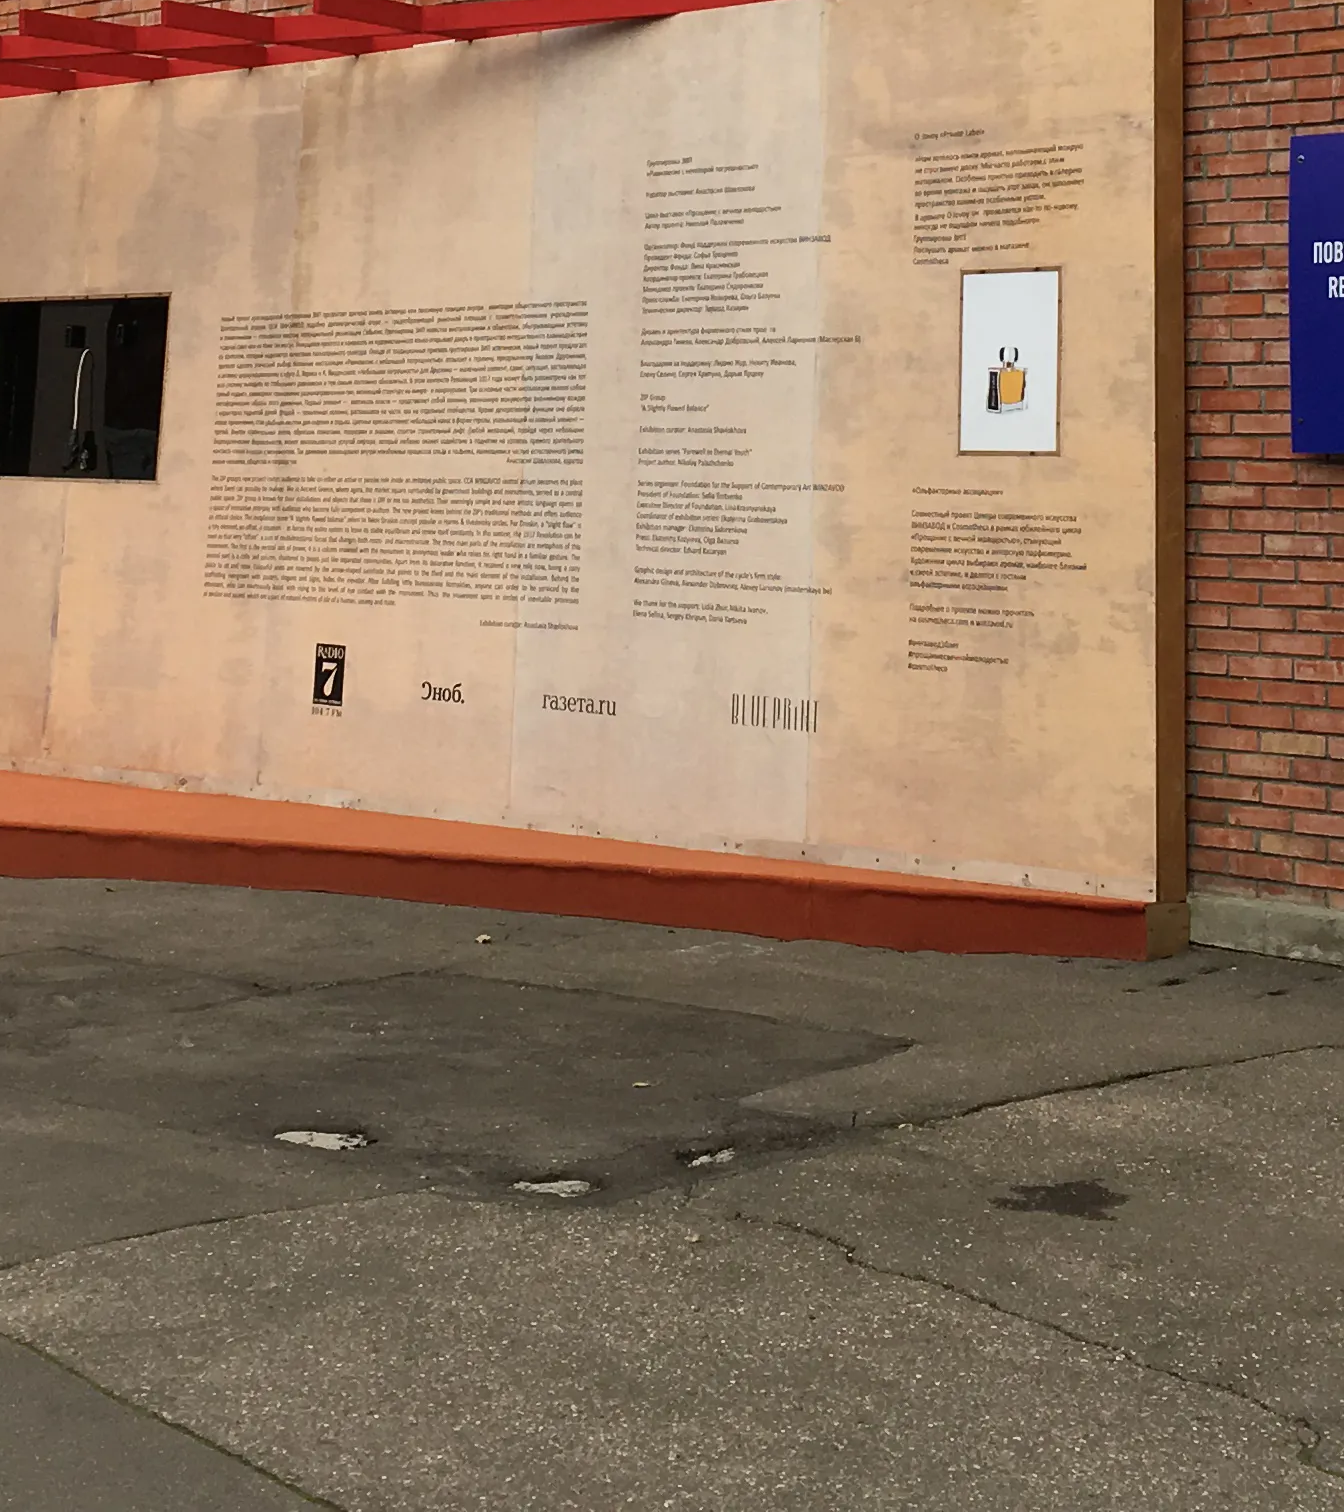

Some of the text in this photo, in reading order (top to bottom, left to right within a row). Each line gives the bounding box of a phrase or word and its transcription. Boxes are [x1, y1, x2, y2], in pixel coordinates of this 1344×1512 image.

[318, 645, 344, 659] RADIO
[322, 662, 338, 696] 7
[543, 694, 616, 716] газета.ru
